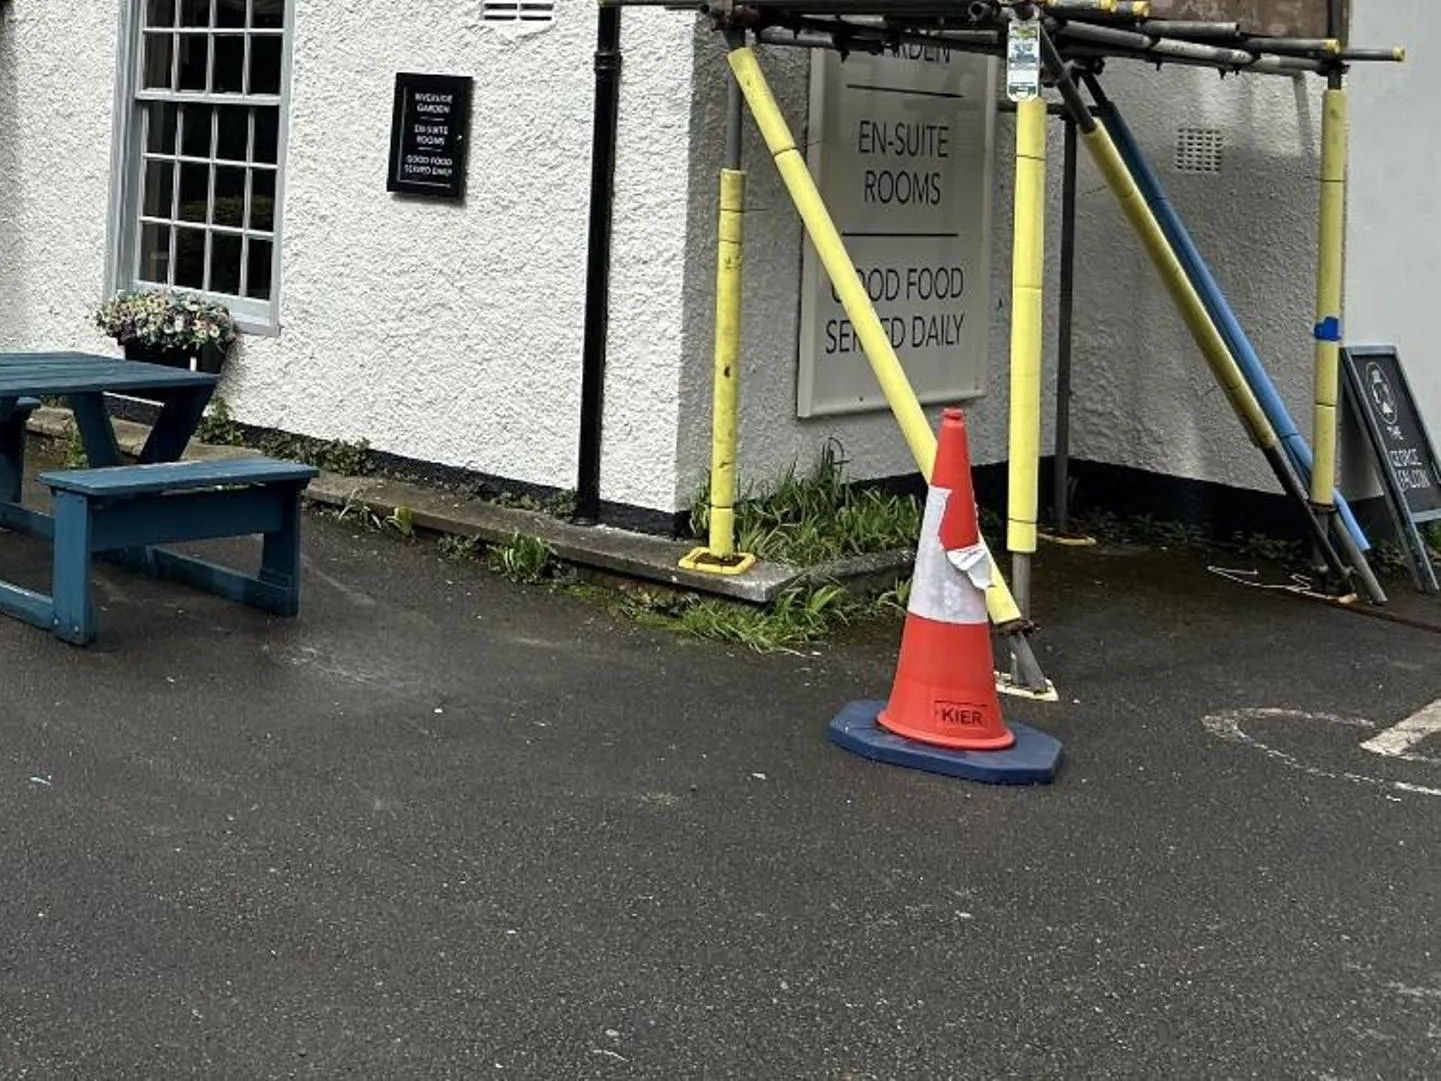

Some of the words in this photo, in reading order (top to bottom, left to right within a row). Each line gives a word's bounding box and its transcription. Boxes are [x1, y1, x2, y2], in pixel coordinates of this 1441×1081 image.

[859, 120, 949, 158] EN-SUITE
[864, 170, 941, 206] ROOMS
[906, 267, 964, 301] FOOD
[911, 313, 965, 348] DAILY
[941, 707, 984, 725] KIER
